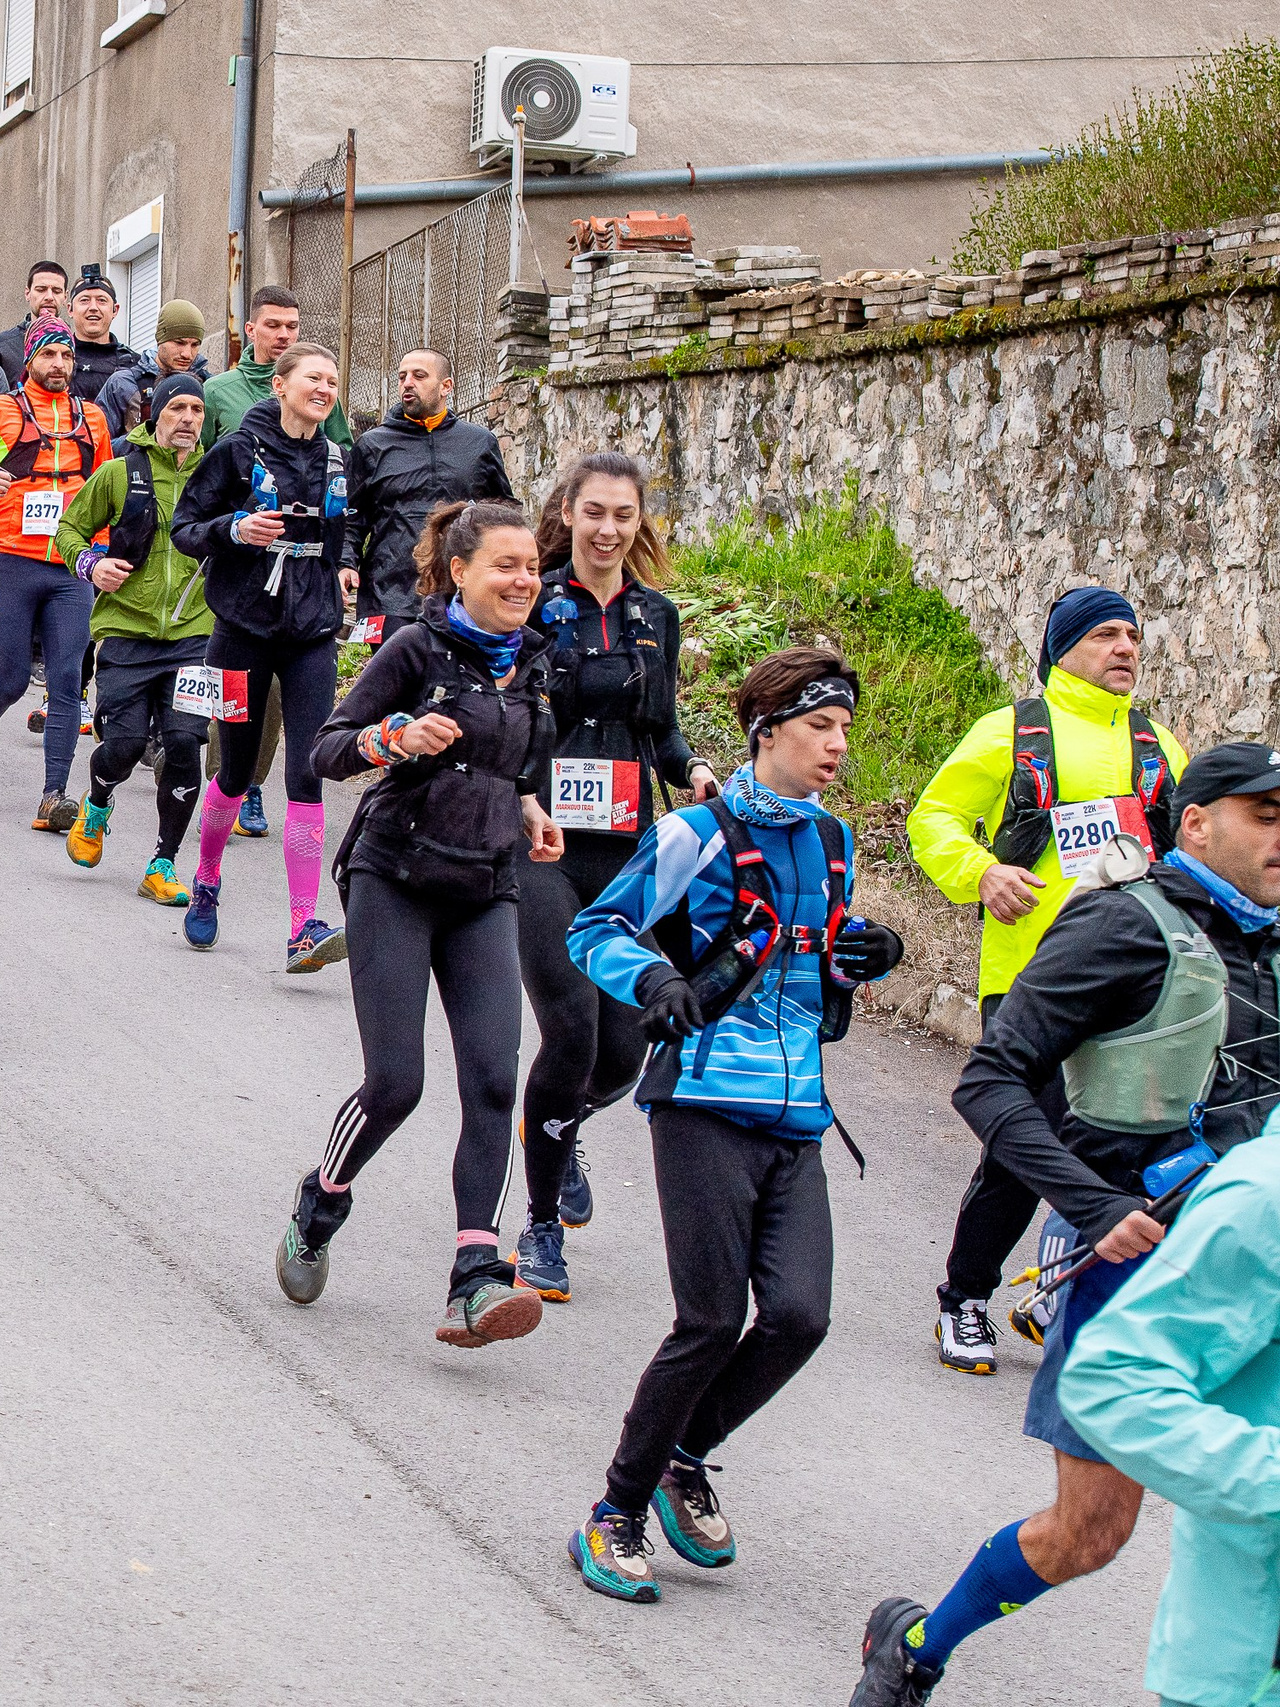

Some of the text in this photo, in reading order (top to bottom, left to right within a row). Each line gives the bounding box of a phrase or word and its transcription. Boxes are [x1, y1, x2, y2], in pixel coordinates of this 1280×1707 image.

[25, 503, 60, 519] 2377
[583, 763, 596, 771] 22K
[560, 779, 603, 802] 2121
[1083, 804, 1097, 814] 22K
[1057, 820, 1115, 851] 2280
[1062, 850, 1089, 860] MARKOVO
